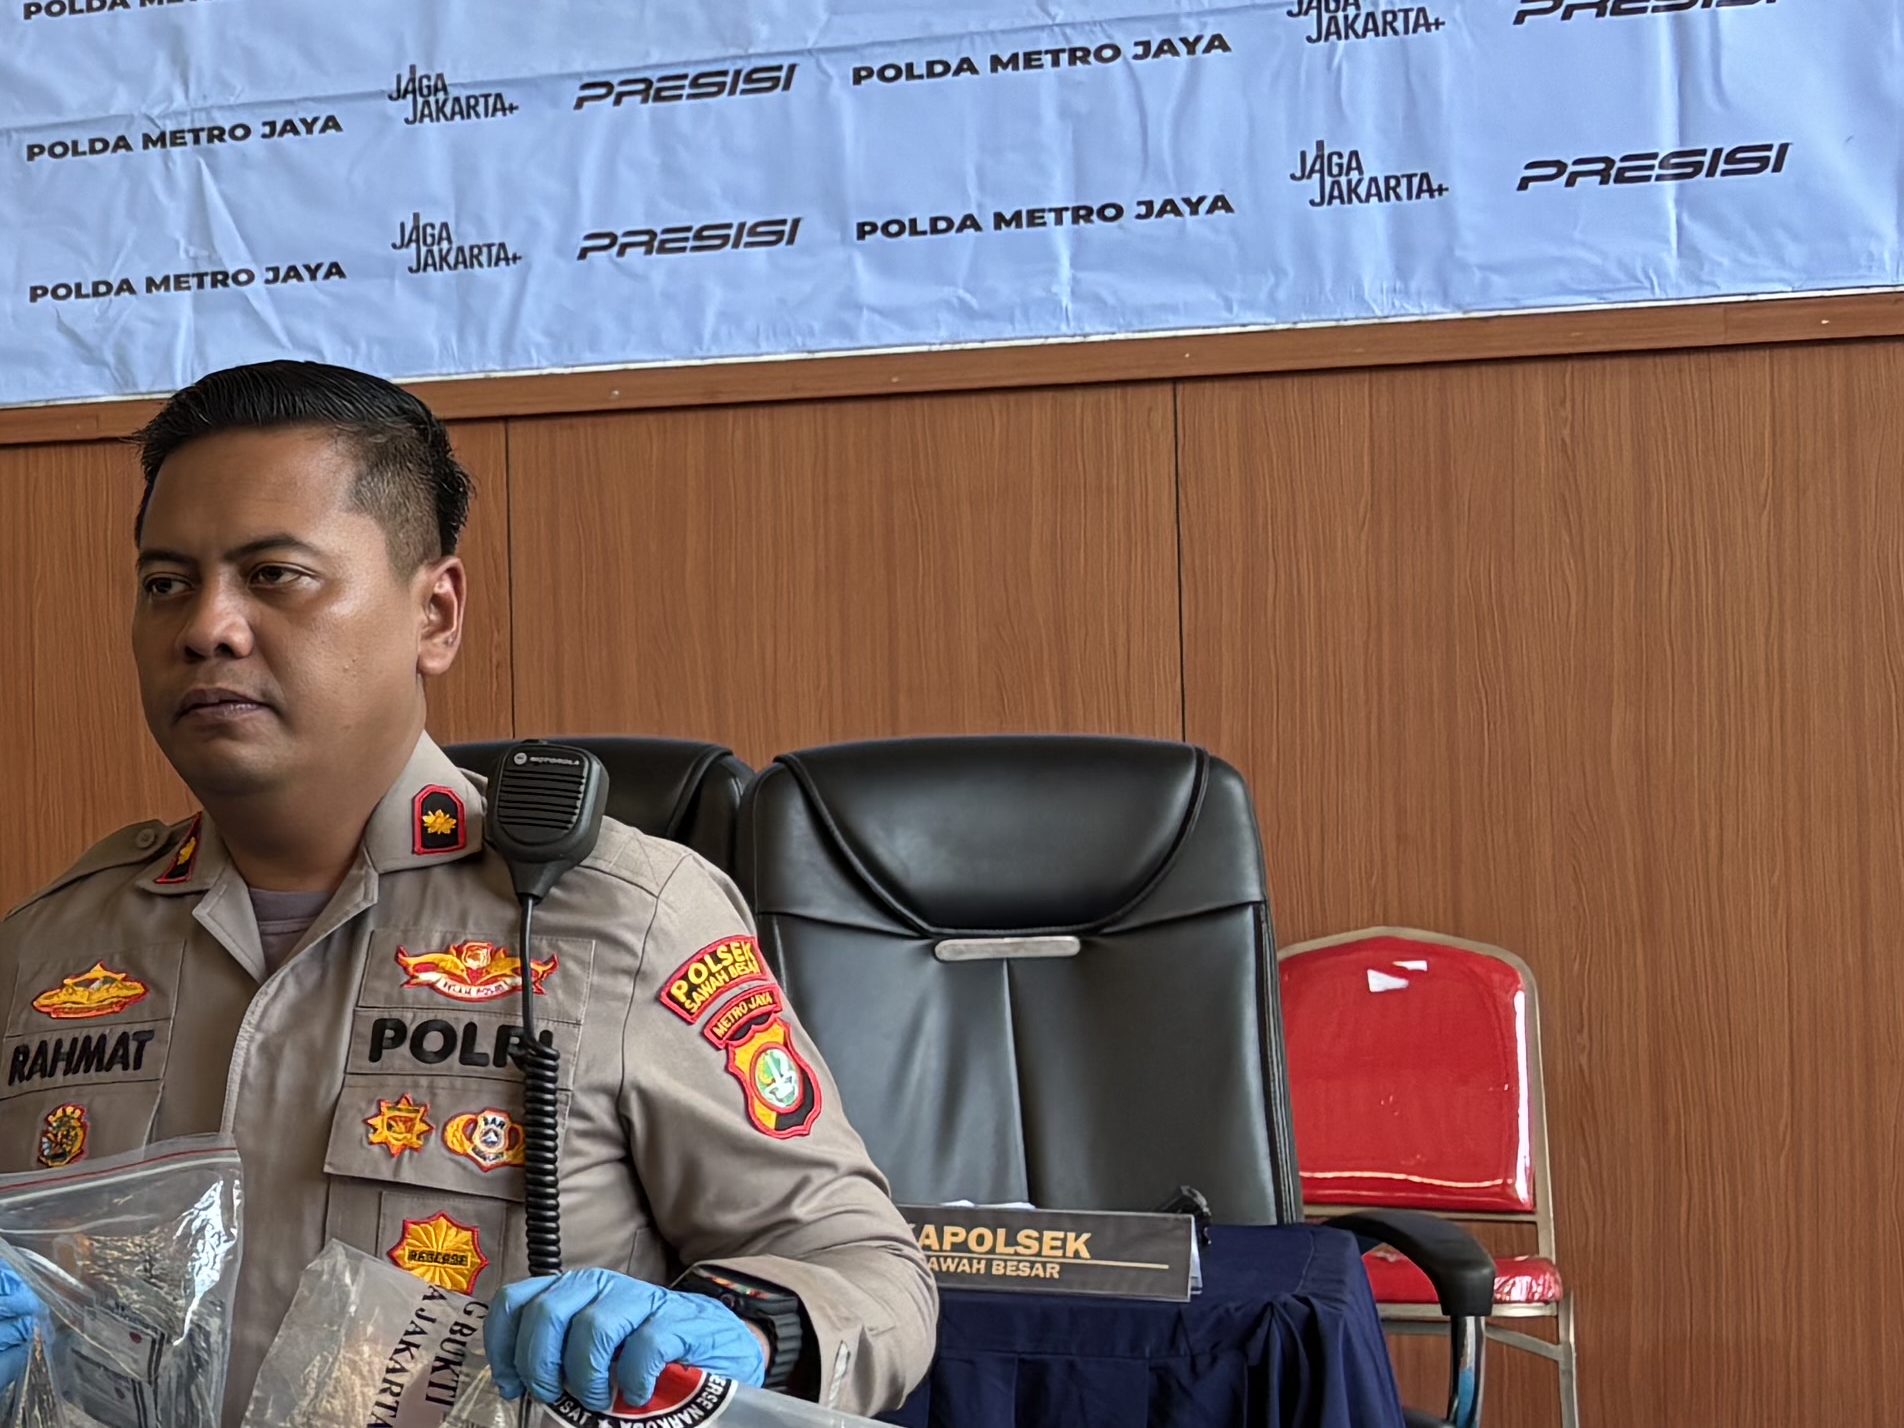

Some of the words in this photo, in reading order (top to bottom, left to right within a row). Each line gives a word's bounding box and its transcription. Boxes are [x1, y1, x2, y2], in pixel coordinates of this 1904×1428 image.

[853, 57, 979, 85] POLDA
[990, 44, 1121, 73] METRO
[1132, 34, 1231, 60] JAYA
[388, 65, 449, 102] JAGA
[574, 63, 797, 110] PRESISI
[27, 135, 133, 161] POLDA
[142, 123, 251, 150] METRO
[261, 115, 342, 139] JAYA
[529, 757, 580, 766] MOTOROLA
[671, 941, 754, 1003] POLSEK
[685, 970, 729, 1013] SAWAH
[713, 1002, 747, 1038] METRO
[749, 992, 773, 1008] JAYA
[9, 1030, 155, 1086] RAHMAT
[909, 1223, 1092, 1259] APOLSEK
[927, 1257, 986, 1275] AWAH
[991, 1261, 1060, 1279] BESAR
[426, 1321, 477, 1407] BUKTI
